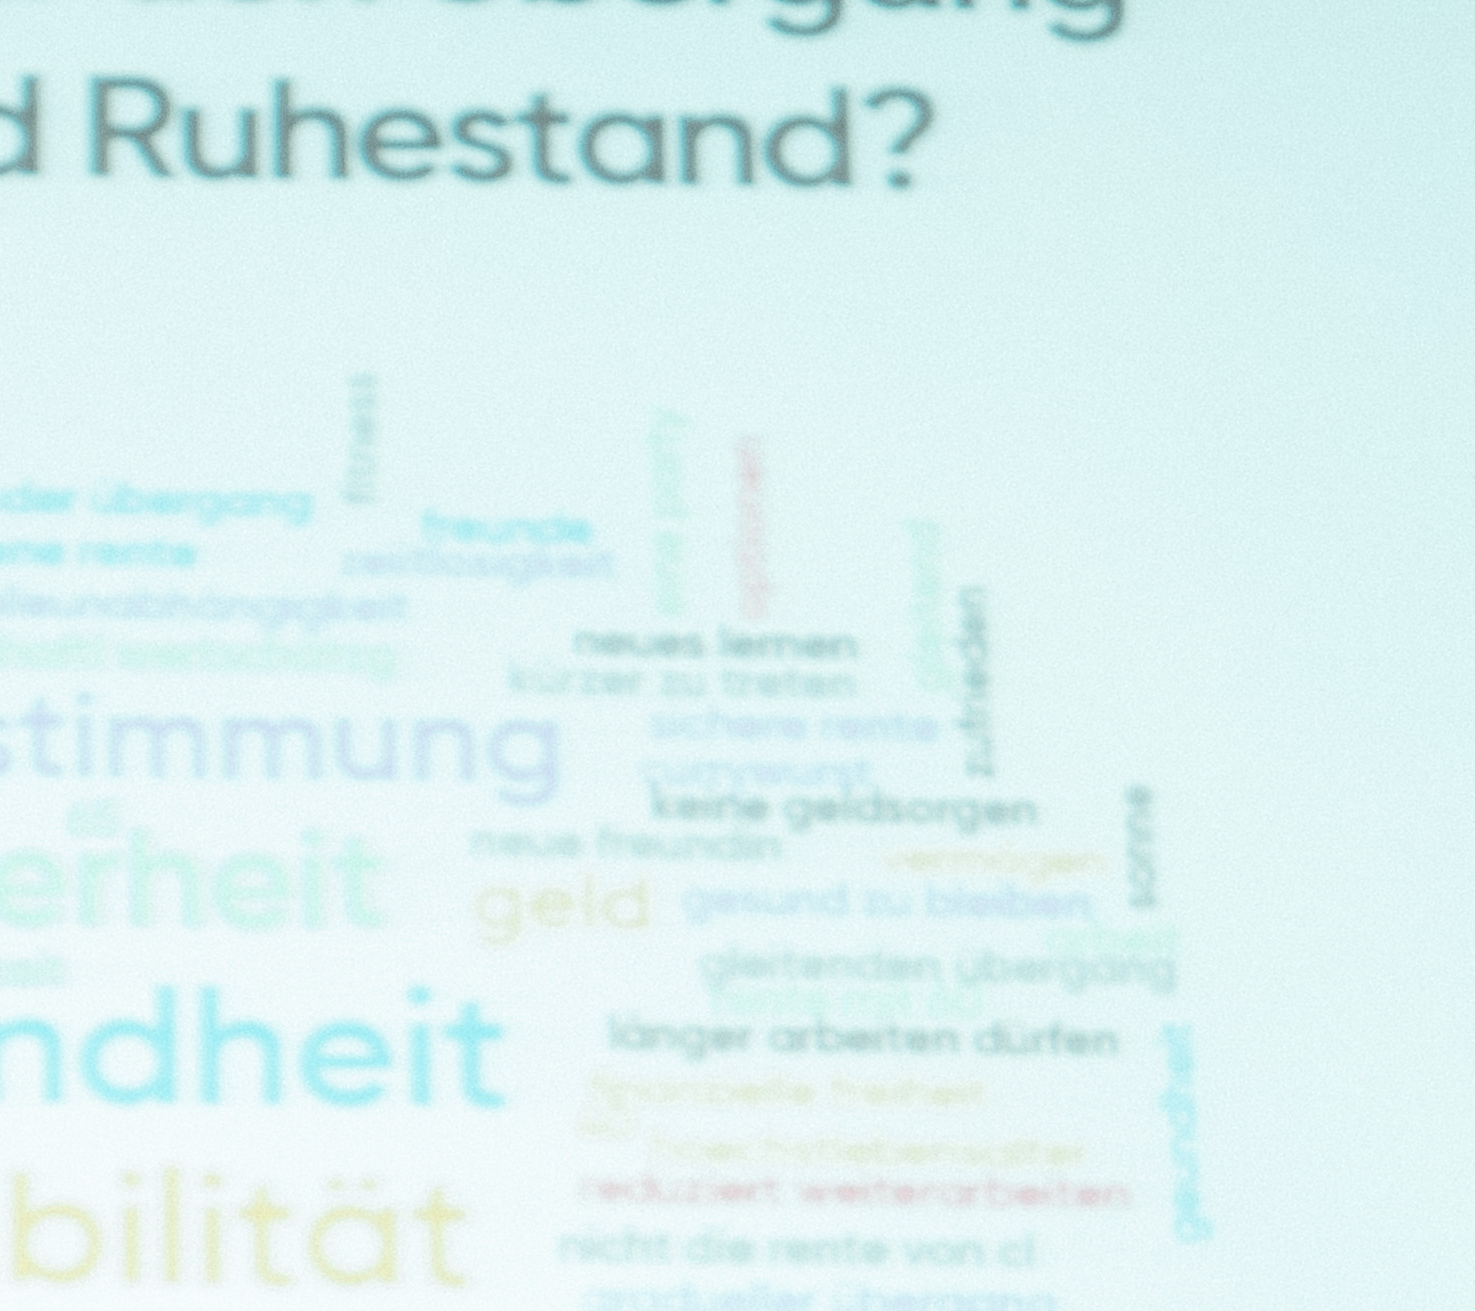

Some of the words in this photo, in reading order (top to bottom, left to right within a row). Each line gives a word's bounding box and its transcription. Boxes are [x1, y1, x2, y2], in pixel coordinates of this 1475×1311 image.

[84, 77, 939, 193] Ruhestand?
[87, 476, 314, 528] übergang
[419, 508, 593, 546] freunde
[75, 539, 198, 569] rente
[570, 629, 705, 660] neues
[716, 625, 861, 661] lernen
[660, 668, 707, 698] zu
[719, 666, 858, 698] treten
[649, 782, 771, 821] keine
[781, 786, 1040, 834] geldsorgen
[469, 830, 584, 860] neue
[594, 826, 785, 862] freundin
[472, 871, 651, 948] geld
[680, 885, 848, 925] gesund
[860, 889, 913, 919] zu
[925, 885, 1093, 922] bleiben
[697, 945, 942, 990] gleitenden
[953, 948, 1178, 997] übergang
[605, 1012, 755, 1063] länger
[765, 1017, 962, 1056] arbeiten
[971, 1017, 1123, 1059] dürfen
[576, 1174, 779, 1204] reduziert
[798, 1178, 1134, 1209] weiterarbeiten
[557, 1228, 671, 1268] nicht
[681, 1230, 757, 1268] die
[766, 1233, 890, 1269] rente
[900, 1238, 988, 1270] von
